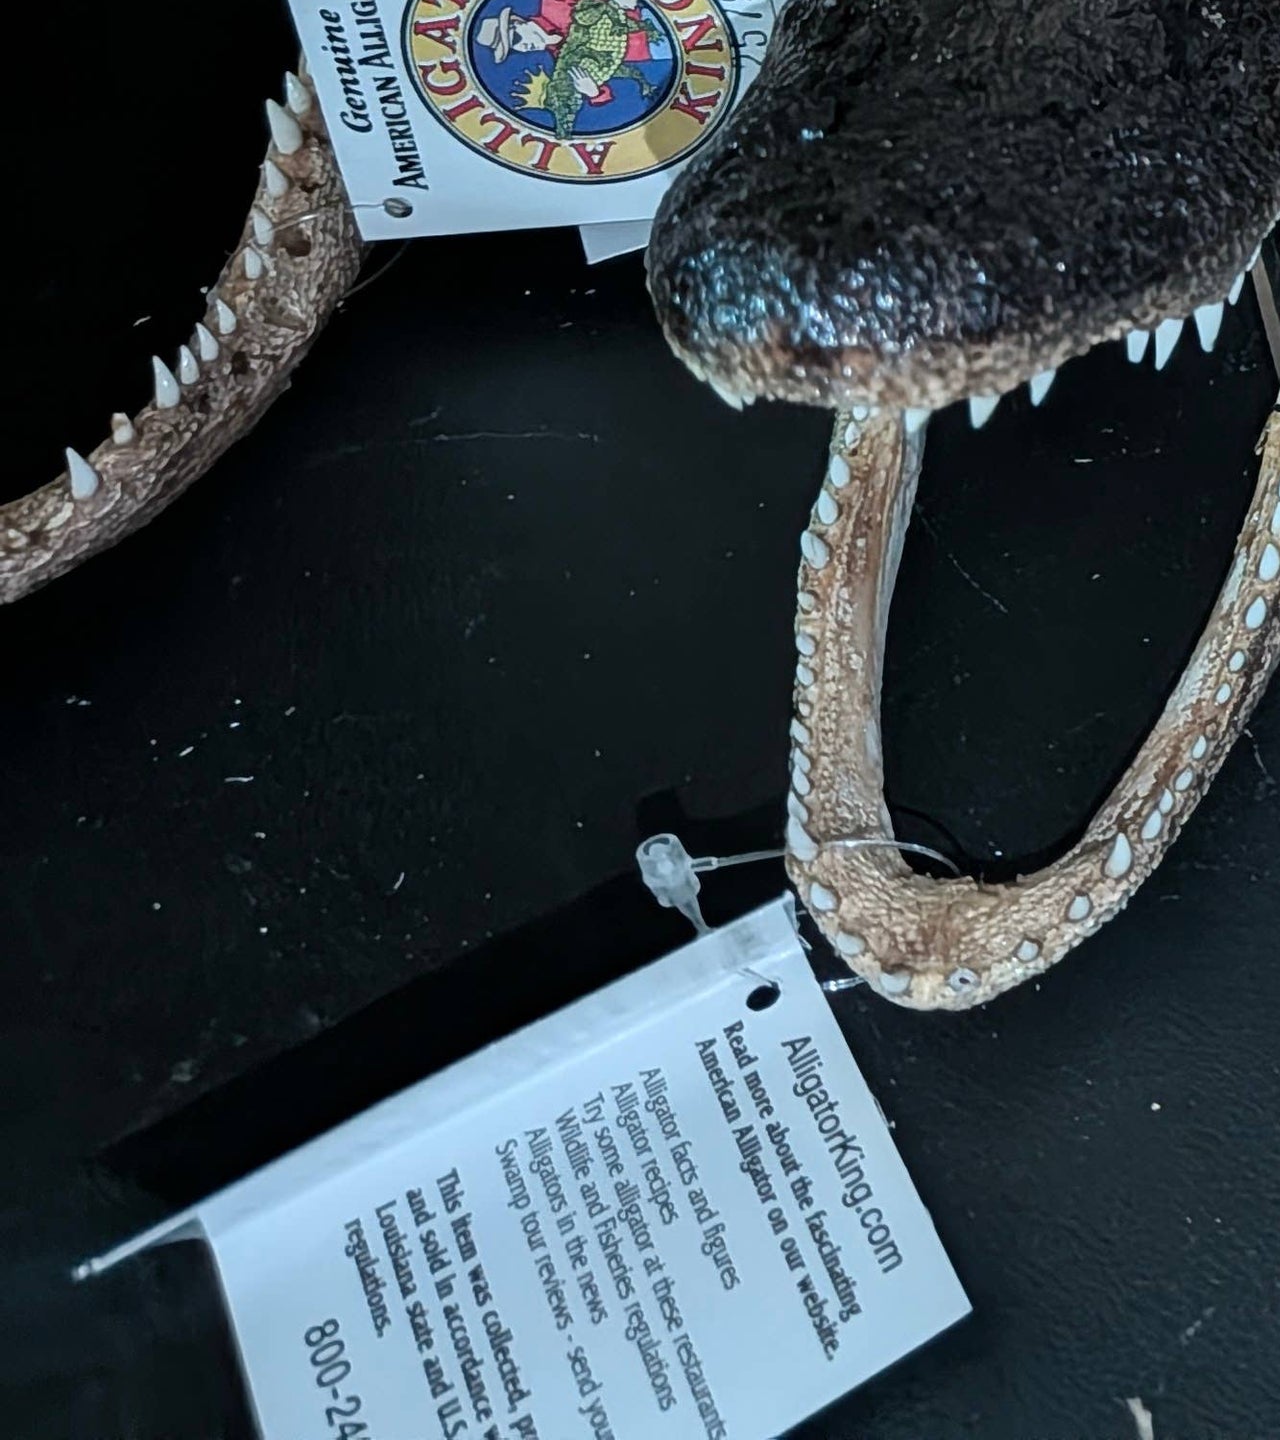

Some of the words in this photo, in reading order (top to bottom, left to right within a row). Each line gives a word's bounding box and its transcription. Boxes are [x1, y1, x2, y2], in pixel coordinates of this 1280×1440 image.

[320, 7, 373, 135] Genuine
[378, 75, 428, 191] AMERICAN
[580, 1090, 605, 1124] Try
[638, 1067, 681, 1141] Alligator
[554, 1106, 595, 1181] Wildlife
[593, 1125, 624, 1178] some
[609, 1081, 653, 1157] Alligator
[640, 1156, 679, 1225] recipes
[669, 1139, 699, 1186] facts
[722, 1019, 759, 1070] Read
[742, 1069, 774, 1119] more
[764, 1120, 803, 1177] about
[789, 1174, 814, 1211] the
[804, 1209, 862, 1323] fascinating
[780, 1035, 903, 1273] AlligatorKing.com
[579, 1180, 611, 1219] and
[613, 1178, 655, 1252] alligator
[687, 1187, 720, 1225] and
[694, 1037, 741, 1124] American
[730, 1123, 777, 1204] Alligator
[766, 1206, 788, 1235] on
[779, 1236, 806, 1272] our
[795, 1272, 839, 1361] website.
[343, 1217, 391, 1338] regulations.
[592, 1215, 636, 1300] Fisheries
[642, 1254, 666, 1277] at
[700, 1221, 741, 1291] figures
[651, 1276, 683, 1333] these
[623, 1300, 677, 1412] regulations
[672, 1332, 727, 1440] restaurants
